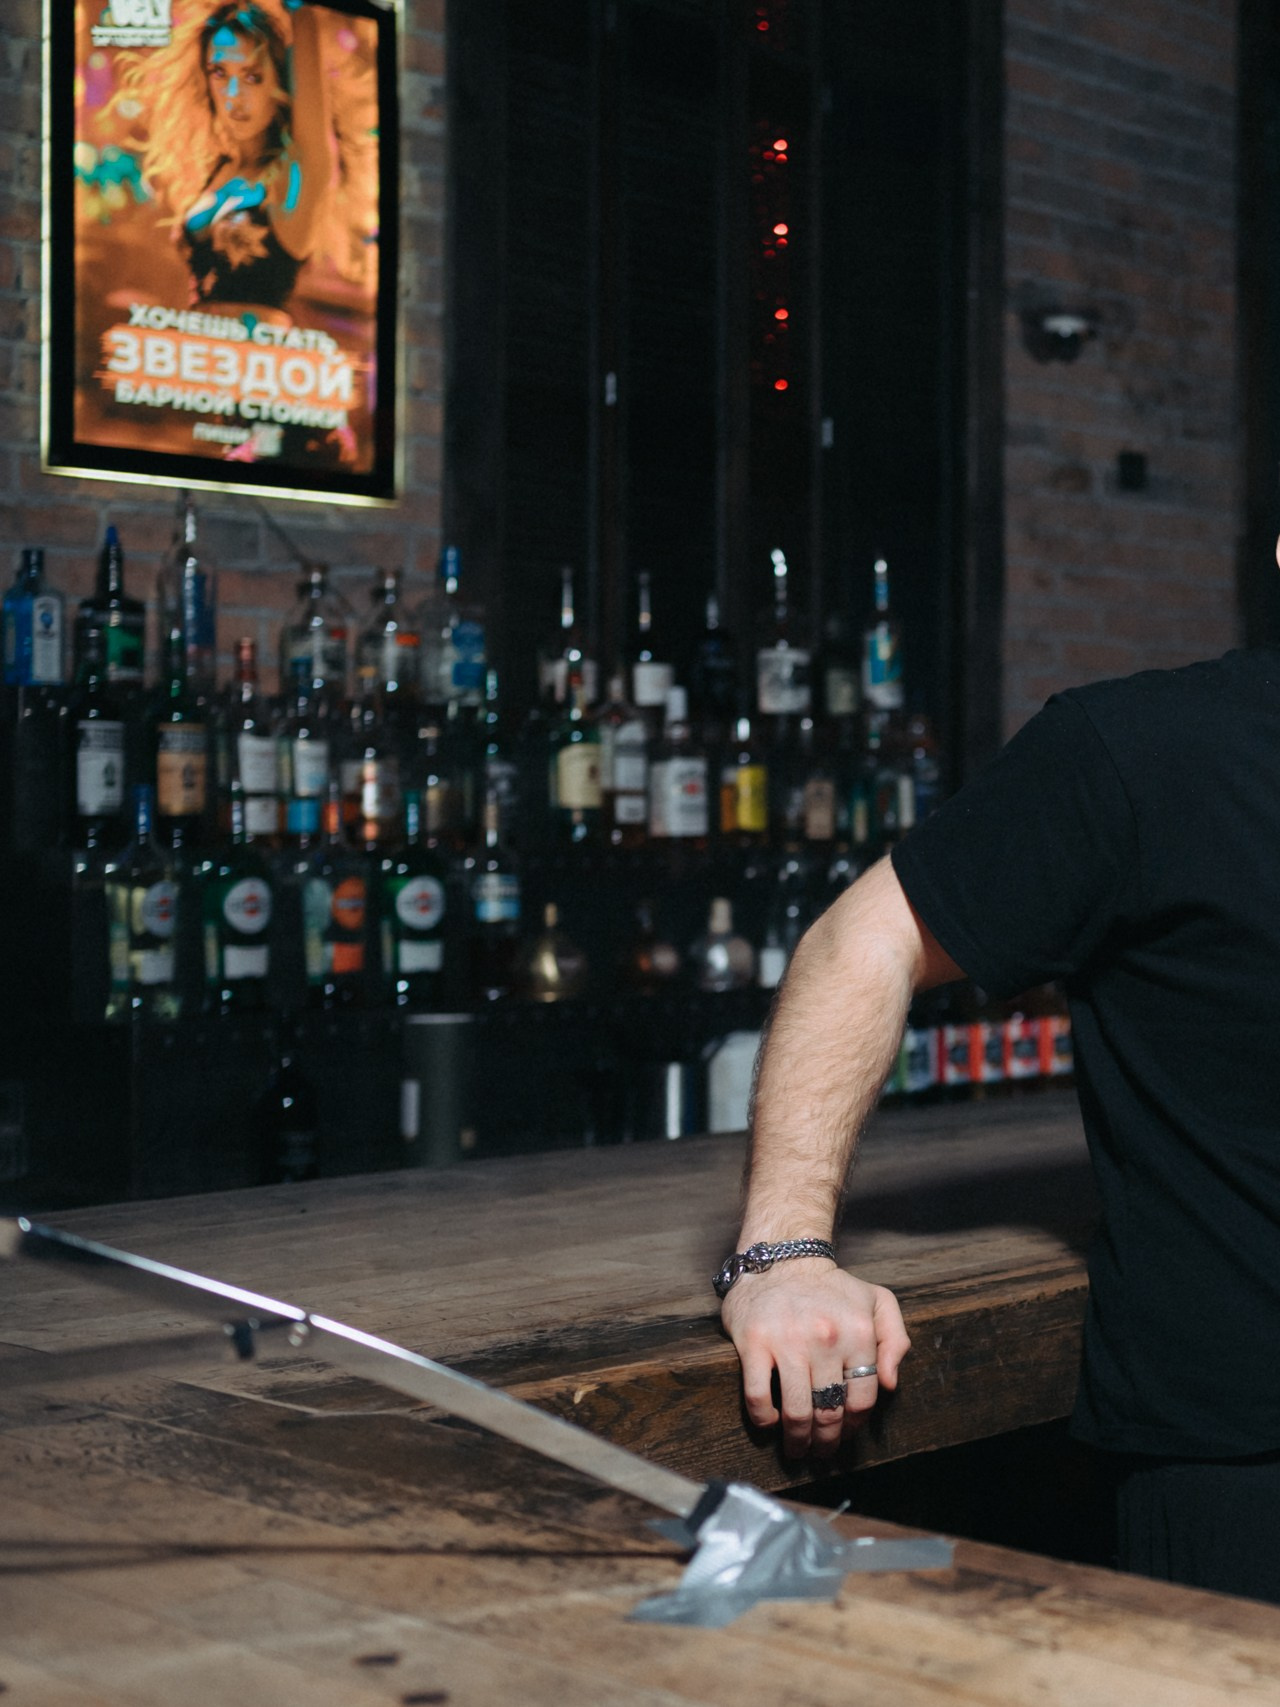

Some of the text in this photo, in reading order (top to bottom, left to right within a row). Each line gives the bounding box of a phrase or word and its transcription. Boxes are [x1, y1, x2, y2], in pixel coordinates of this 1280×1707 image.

[128, 303, 338, 351] ХОЧЕШЬ СТАТЬ
[108, 331, 354, 400] ЗВЕЗДОЙ
[238, 398, 348, 429] СТОЙКИ
